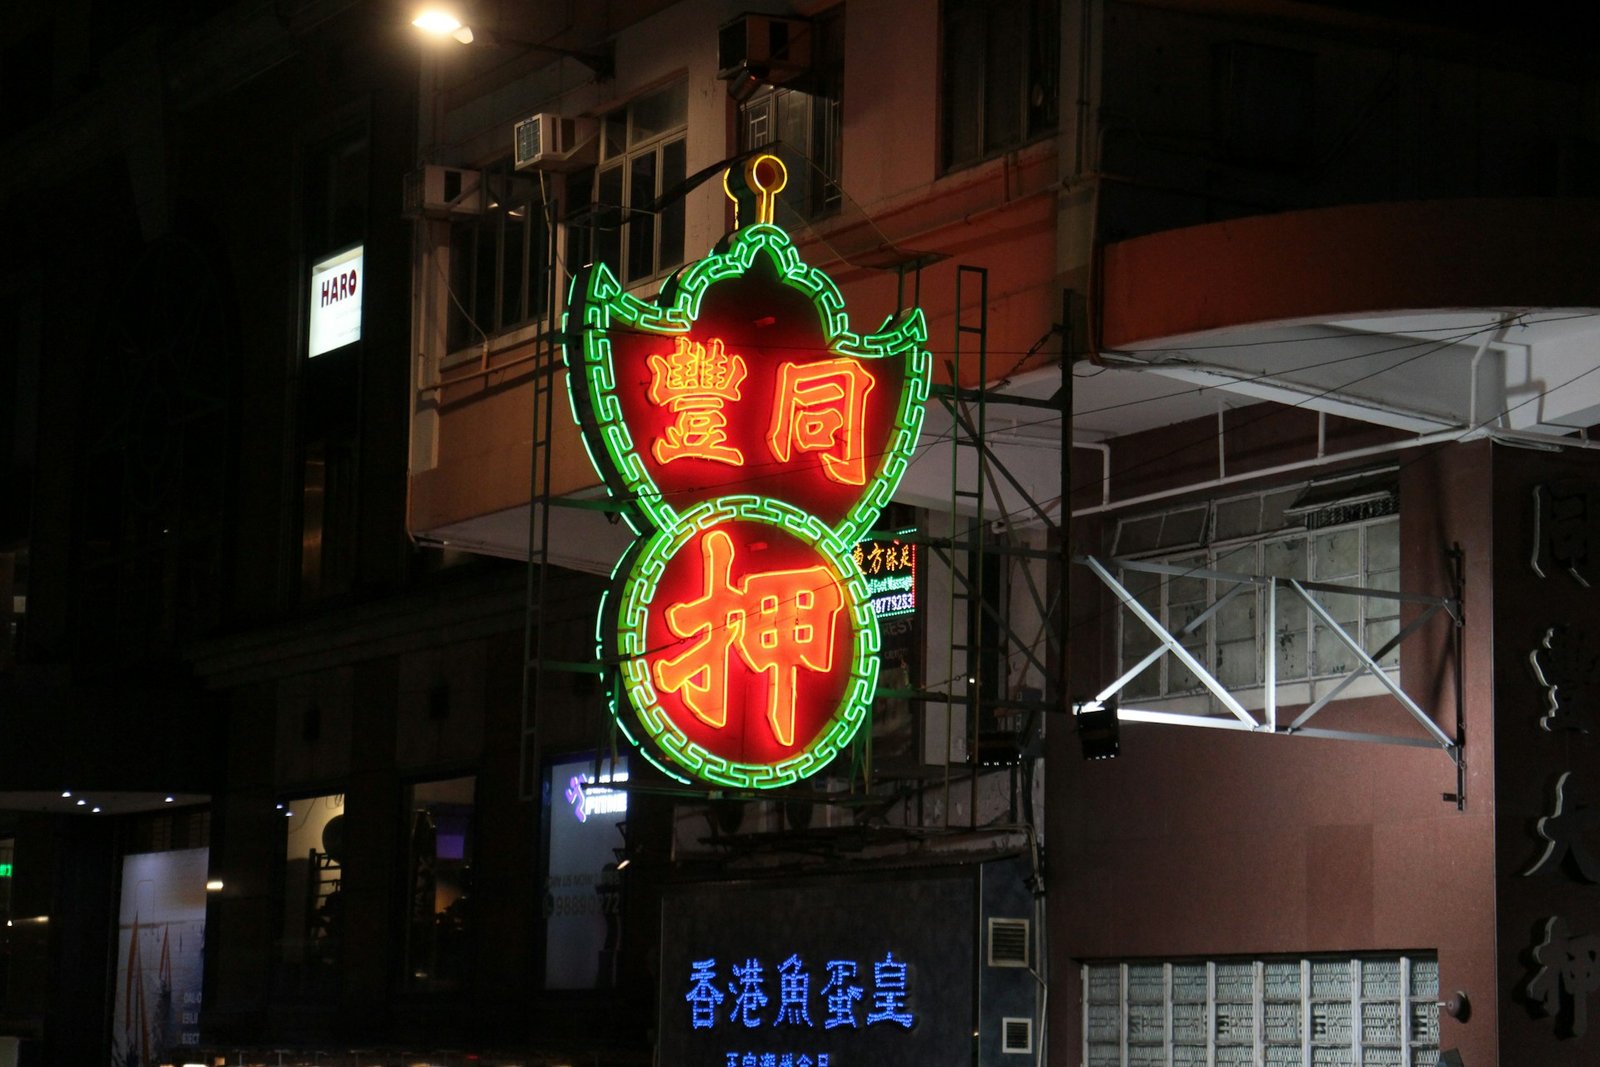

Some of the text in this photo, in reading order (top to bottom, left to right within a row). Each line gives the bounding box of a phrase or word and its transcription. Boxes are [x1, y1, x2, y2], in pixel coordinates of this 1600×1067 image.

[321, 269, 357, 308] HARO
[654, 530, 844, 747] 押
[685, 951, 913, 1029] 香港魚蛋皇
